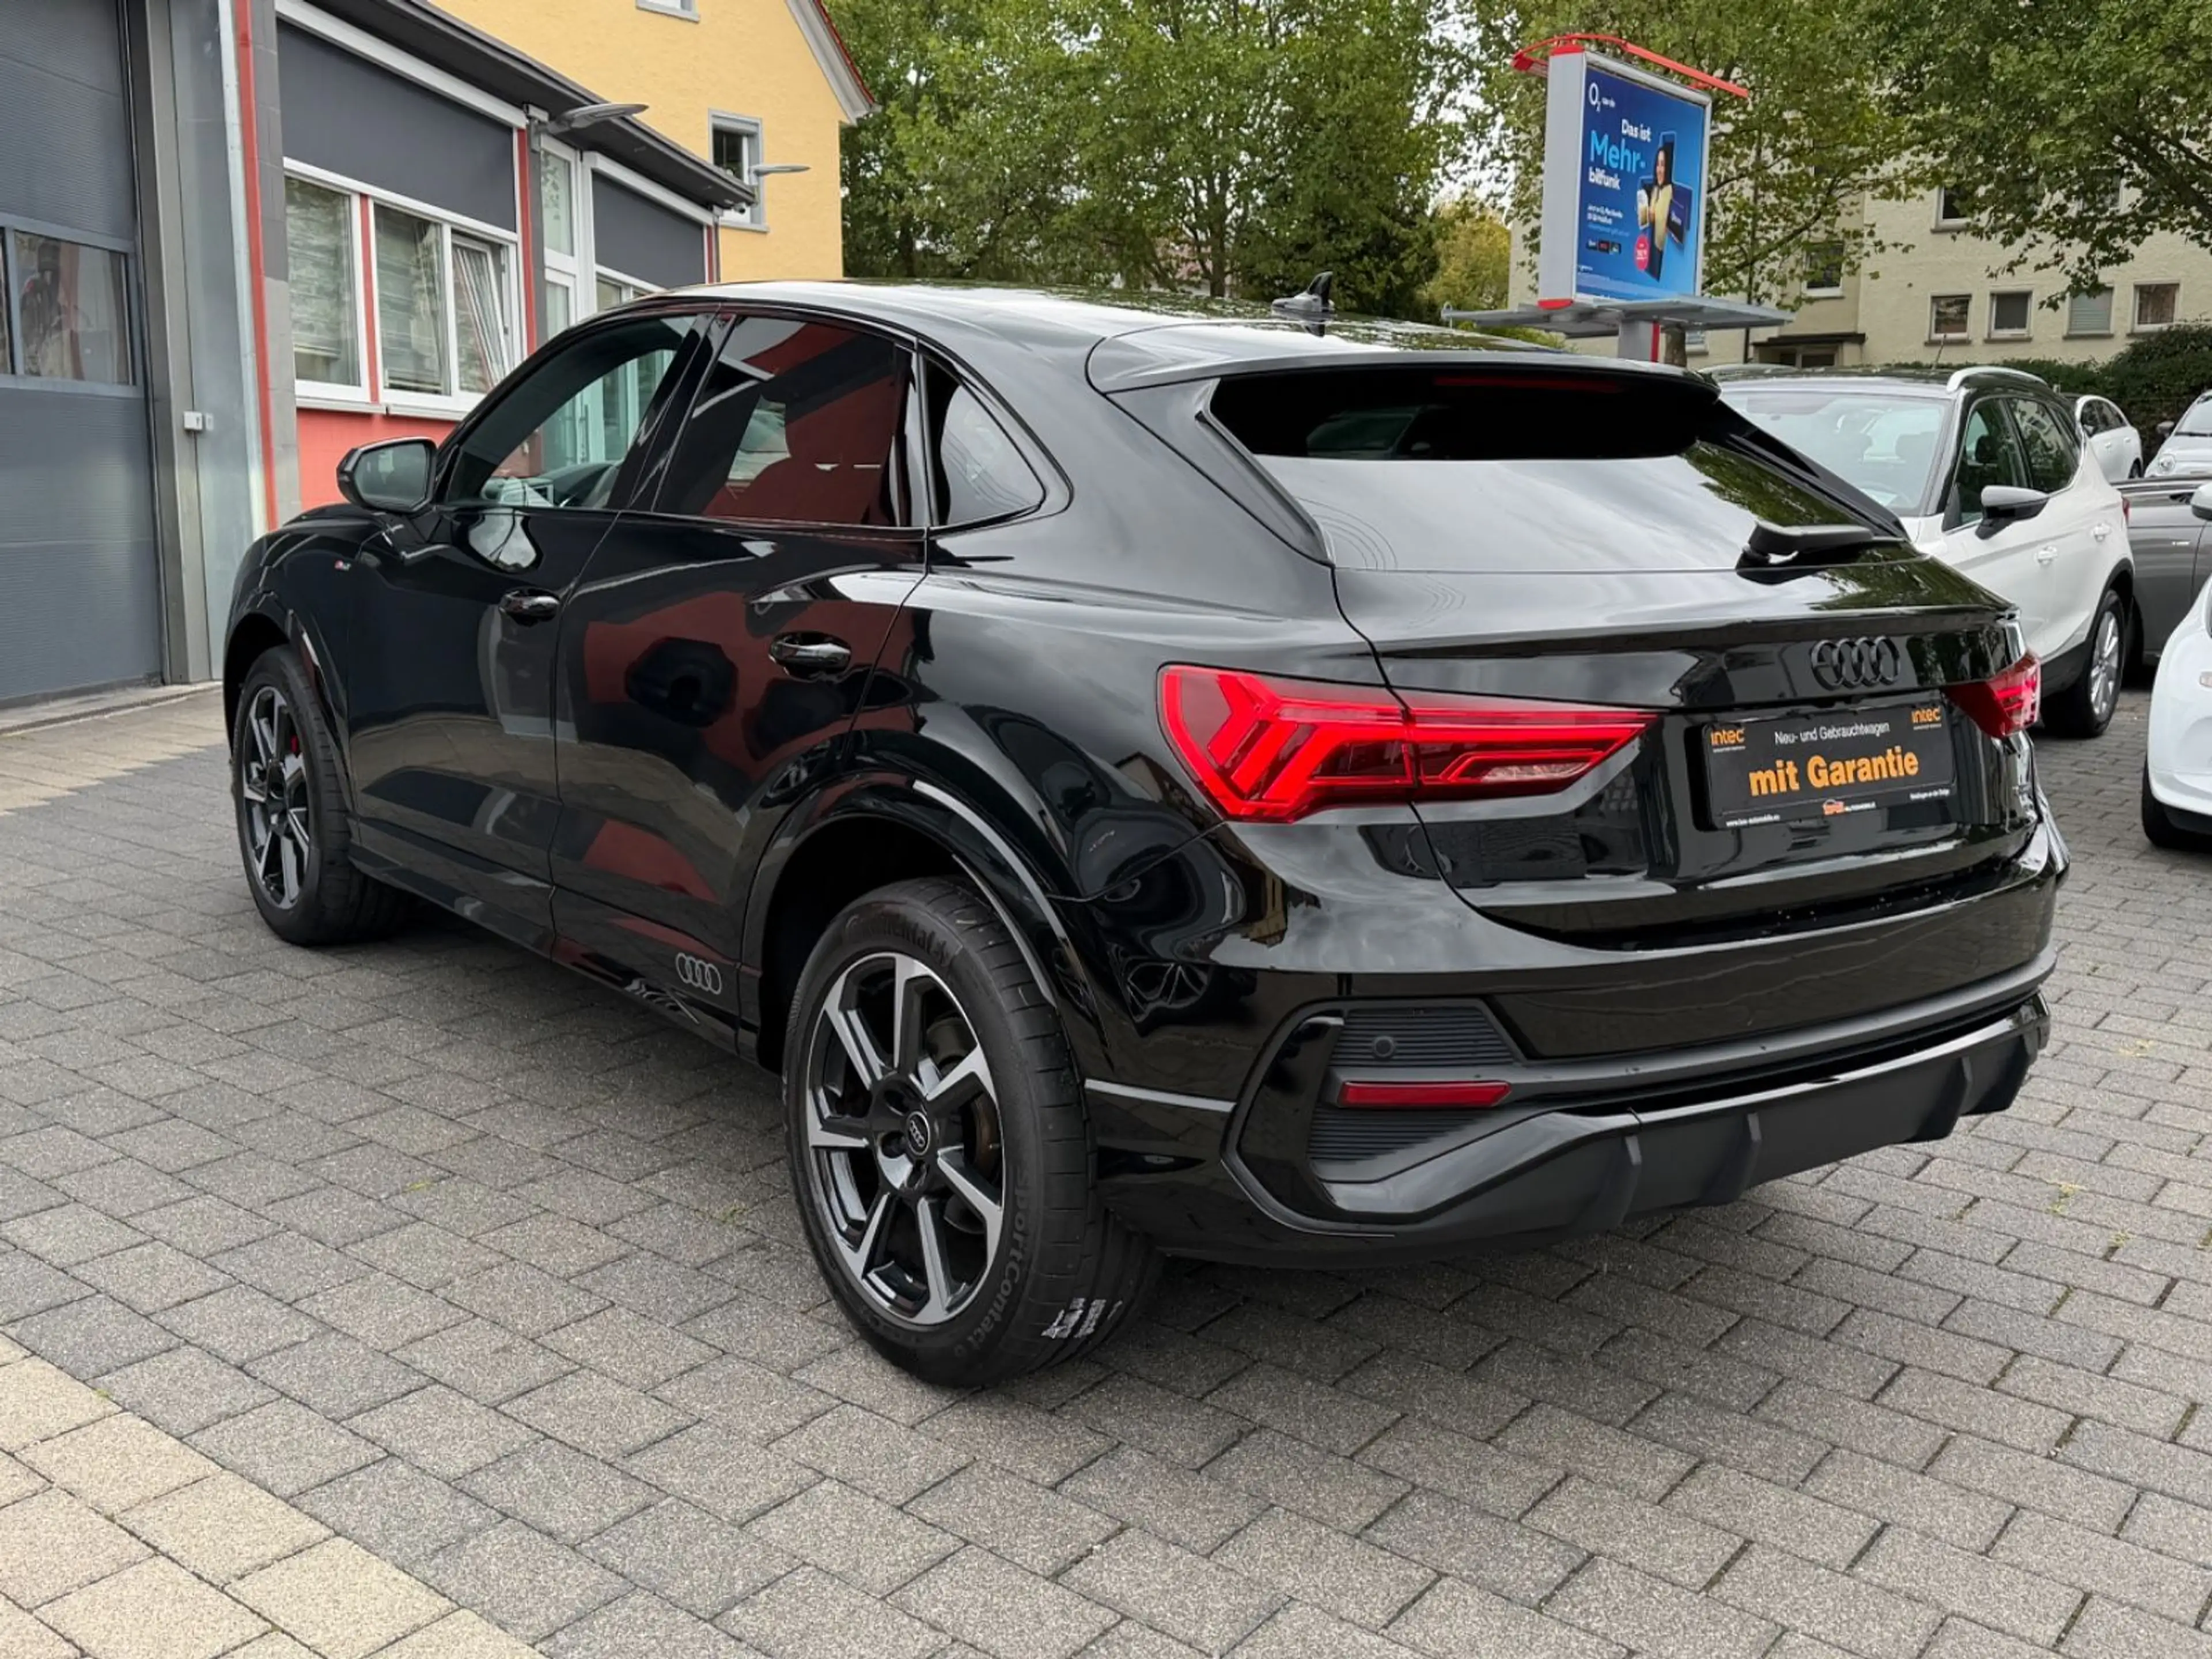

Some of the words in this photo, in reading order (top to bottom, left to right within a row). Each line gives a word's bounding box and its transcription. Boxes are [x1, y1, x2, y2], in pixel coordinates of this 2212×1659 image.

[1622, 119, 1638, 138] Das
[1639, 123, 1652, 142] ist
[1774, 730, 1798, 745] Neu-
[1800, 727, 1817, 743] und
[1819, 722, 1890, 741] Gebrauchtwagen
[1749, 759, 1800, 796] mit
[1807, 745, 1919, 788] Garantie
